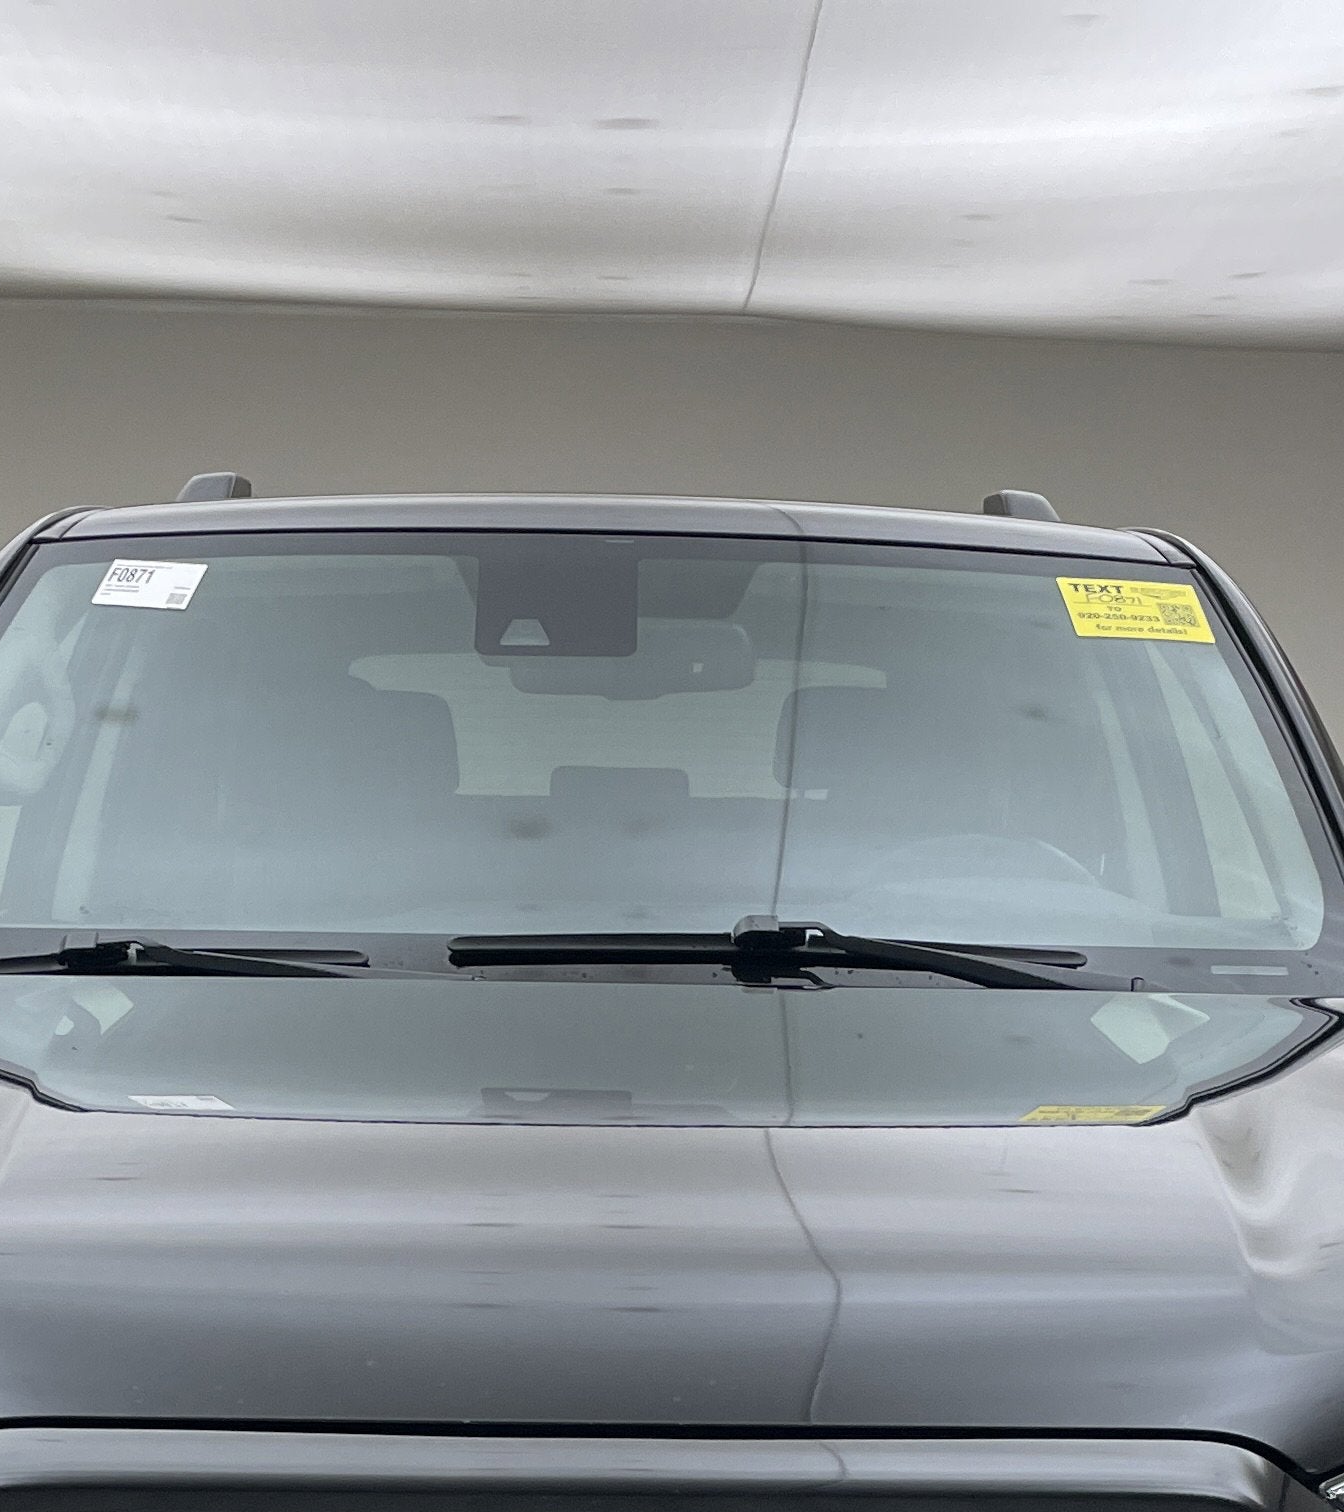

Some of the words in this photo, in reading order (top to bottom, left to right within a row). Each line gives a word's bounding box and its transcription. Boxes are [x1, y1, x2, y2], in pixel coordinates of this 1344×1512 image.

[108, 567, 156, 584] F0871
[1068, 583, 1123, 594] TEXT
[1096, 623, 1112, 631] for
